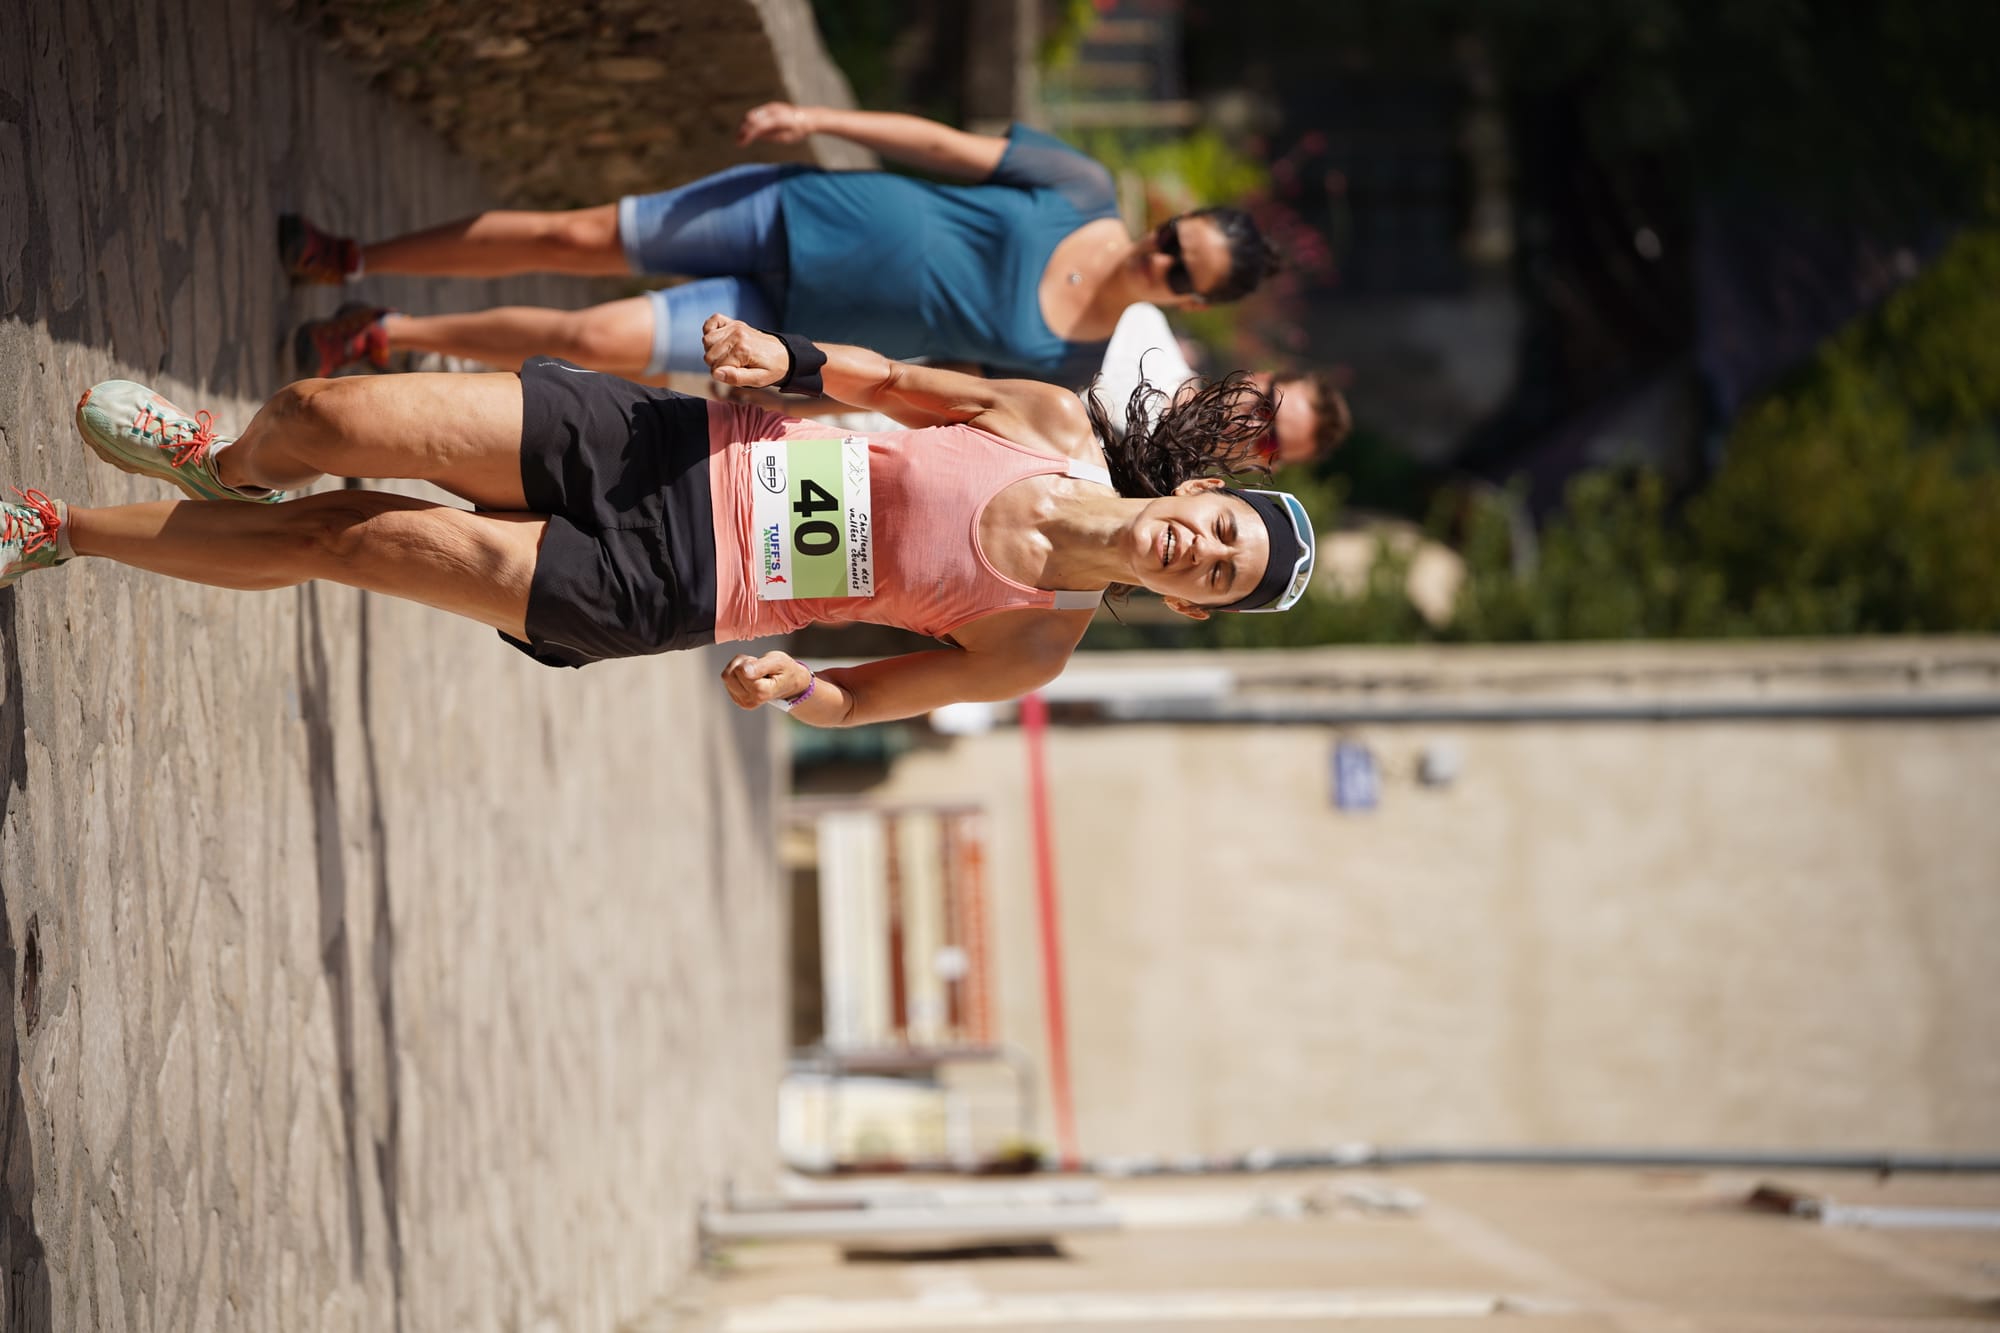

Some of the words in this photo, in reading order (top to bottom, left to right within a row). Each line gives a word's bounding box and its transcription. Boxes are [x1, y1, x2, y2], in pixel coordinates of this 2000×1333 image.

[766, 456, 776, 489] BFP
[793, 479, 840, 556] 40
[849, 508, 859, 542] vallées
[857, 513, 868, 563] Challenge
[763, 528, 773, 576] Aventure
[769, 523, 780, 571] TUFF'S
[851, 548, 861, 590] cévenoles
[861, 568, 869, 584] des
